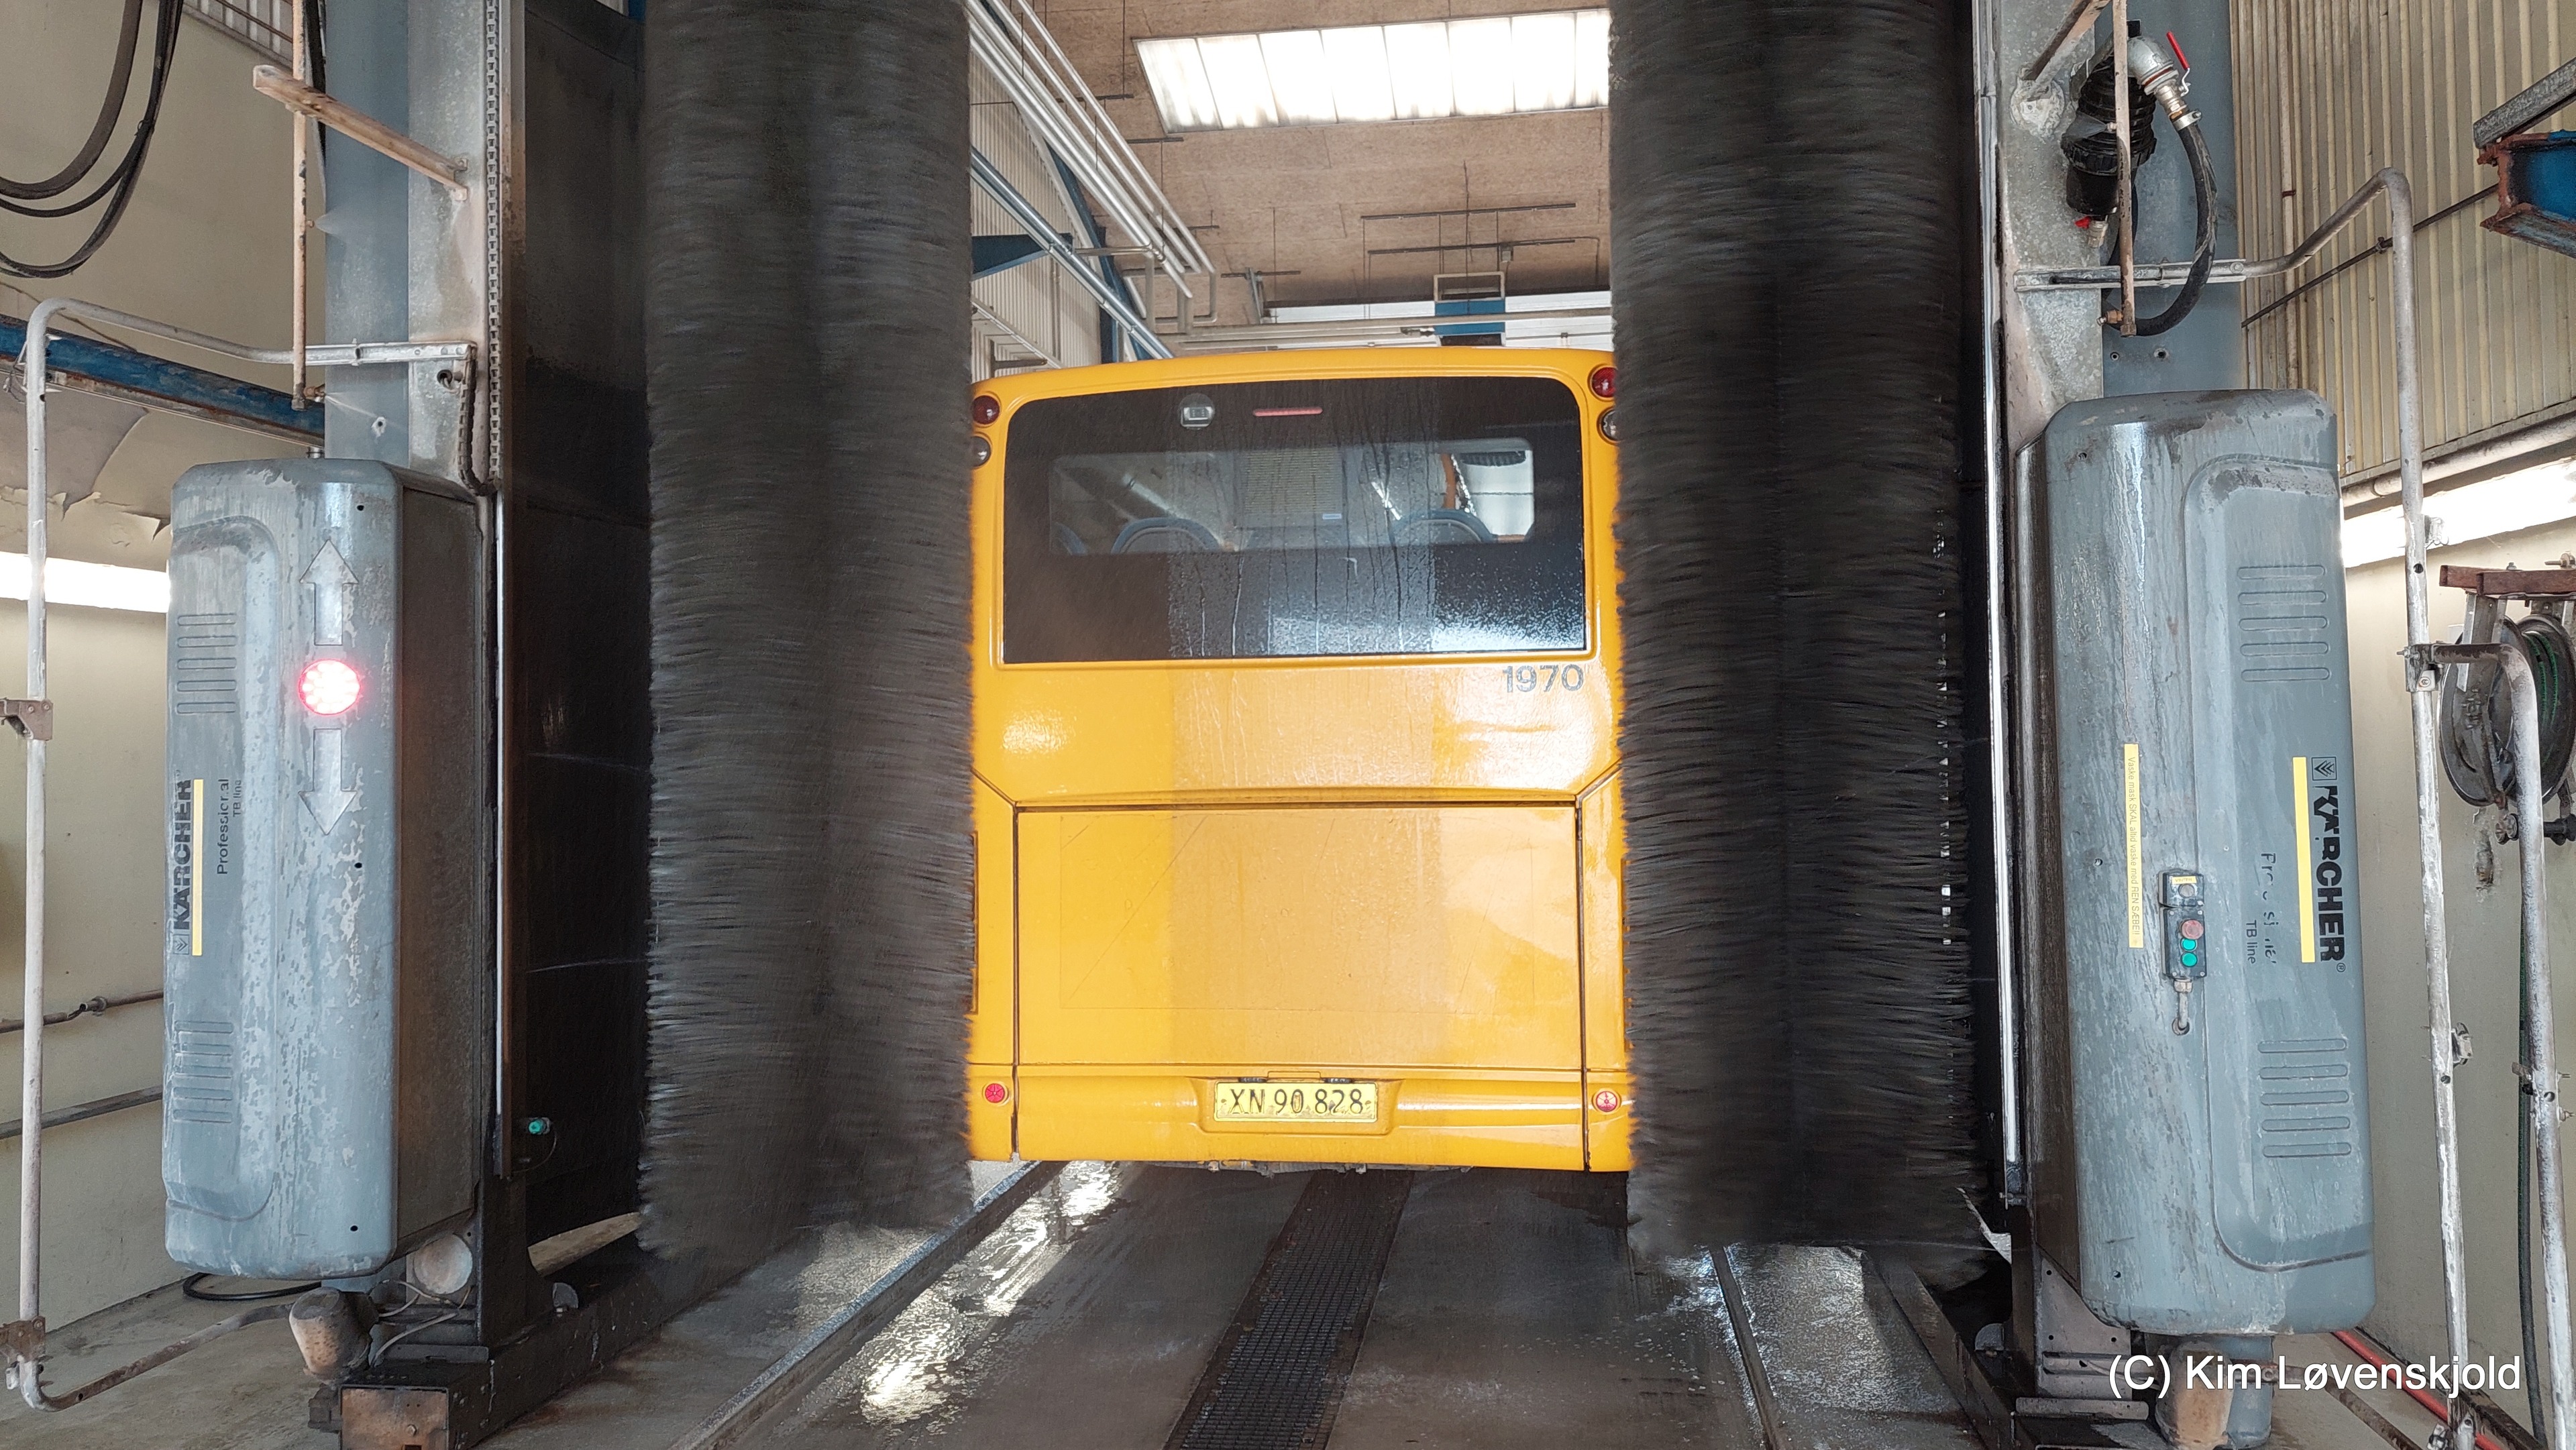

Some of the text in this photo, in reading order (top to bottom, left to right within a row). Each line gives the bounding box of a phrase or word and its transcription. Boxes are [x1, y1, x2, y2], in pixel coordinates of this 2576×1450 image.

[1503, 663, 1585, 693] 1970
[2127, 756, 2136, 780] Vaske
[2129, 781, 2137, 801] mask
[232, 802, 241, 817] TB
[2129, 803, 2137, 825] SKAL
[2129, 827, 2138, 842] altid
[2130, 844, 2138, 866] vaske
[2131, 868, 2139, 885] med
[2131, 886, 2139, 903] REN
[2246, 919, 2258, 964] TB line
[1229, 1089, 1363, 1115] XN 90 828
